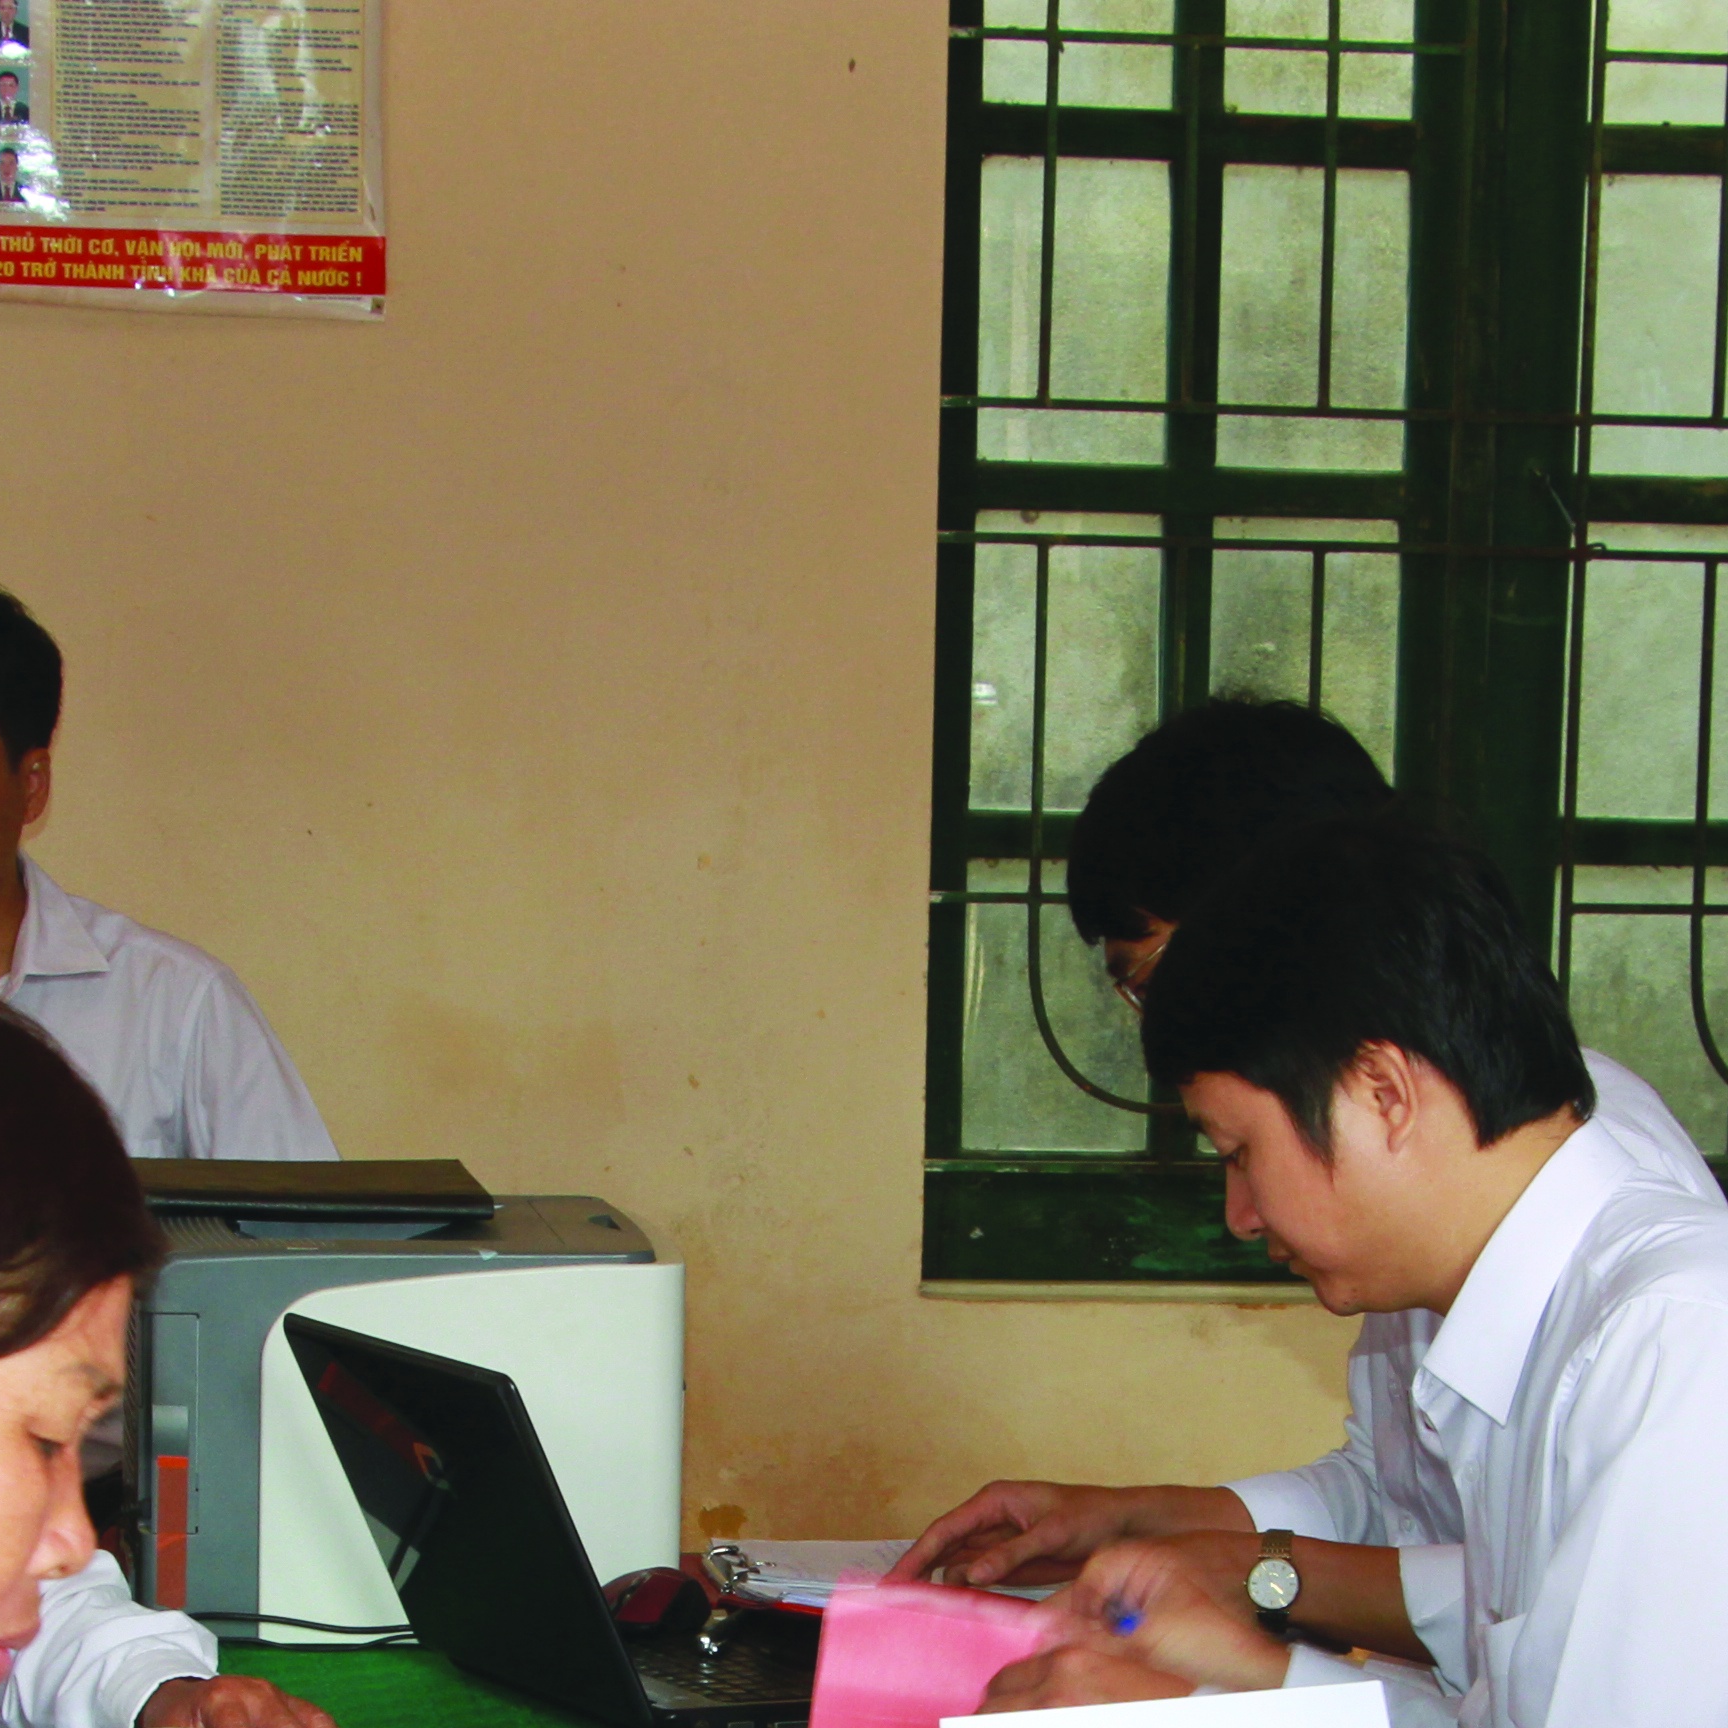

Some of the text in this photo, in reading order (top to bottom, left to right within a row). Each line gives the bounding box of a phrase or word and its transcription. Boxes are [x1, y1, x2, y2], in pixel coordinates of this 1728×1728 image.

[0, 231, 35, 253] THỦ
[41, 235, 82, 255] THỜI
[89, 238, 119, 257] CƠ,
[125, 236, 164, 259] VẬN
[169, 240, 201, 260] HỘI
[254, 240, 301, 261] PHÁT
[309, 239, 363, 262] TRIỂN
[21, 257, 57, 278] TRỞ
[63, 260, 124, 280] THÀNH
[224, 265, 261, 285] CỦA
[267, 264, 292, 286] CẢ
[297, 267, 349, 287] NƯỚC
